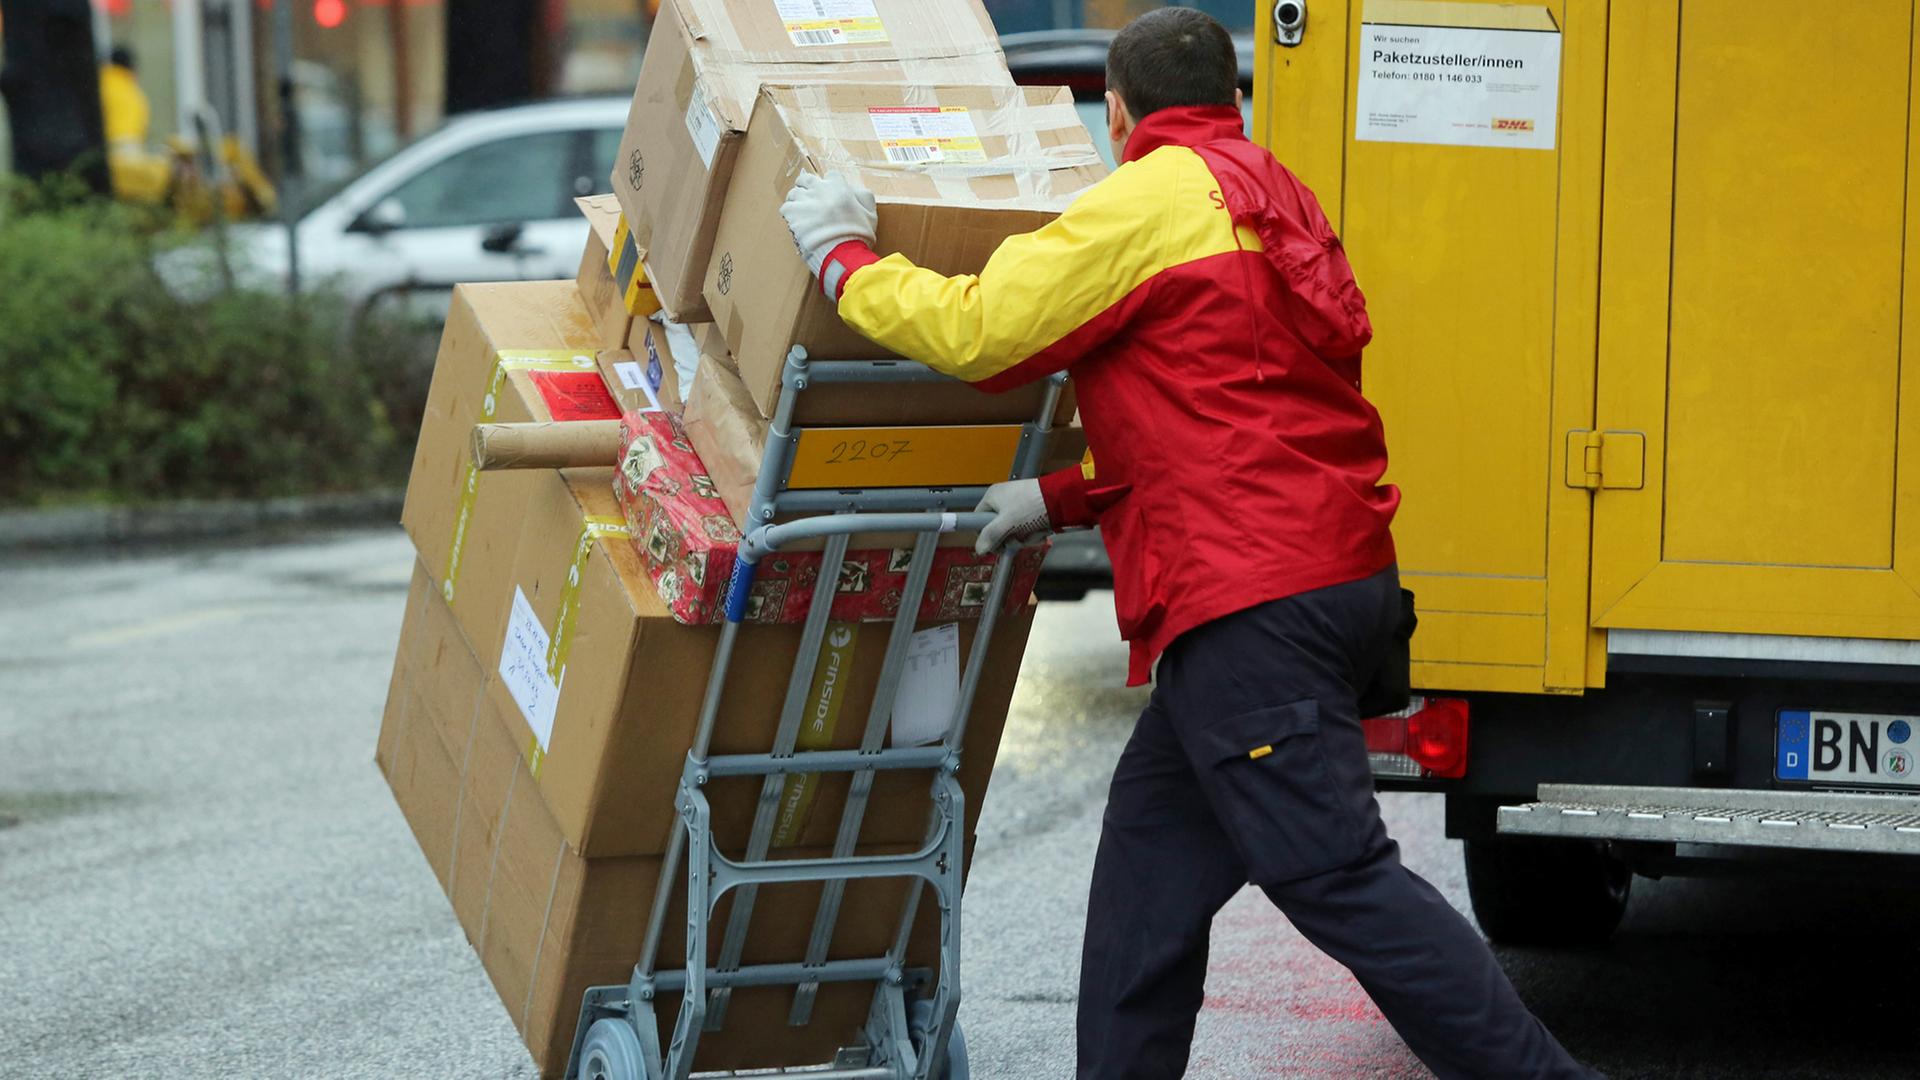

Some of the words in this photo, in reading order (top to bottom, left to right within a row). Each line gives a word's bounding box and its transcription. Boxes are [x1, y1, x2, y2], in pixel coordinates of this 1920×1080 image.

[1373, 34, 1387, 43] Wir
[1389, 35, 1420, 44] suchen
[1372, 50, 1524, 69] Paketzusteller/innen
[1372, 70, 1411, 81] Telefon:
[1412, 71, 1436, 81] 0180
[1446, 74, 1464, 83] 146
[1465, 74, 1482, 83] 033
[1496, 119, 1529, 130] DHL
[825, 439, 913, 463] 2207
[1786, 752, 1799, 768] D
[1813, 719, 1880, 774] BN
